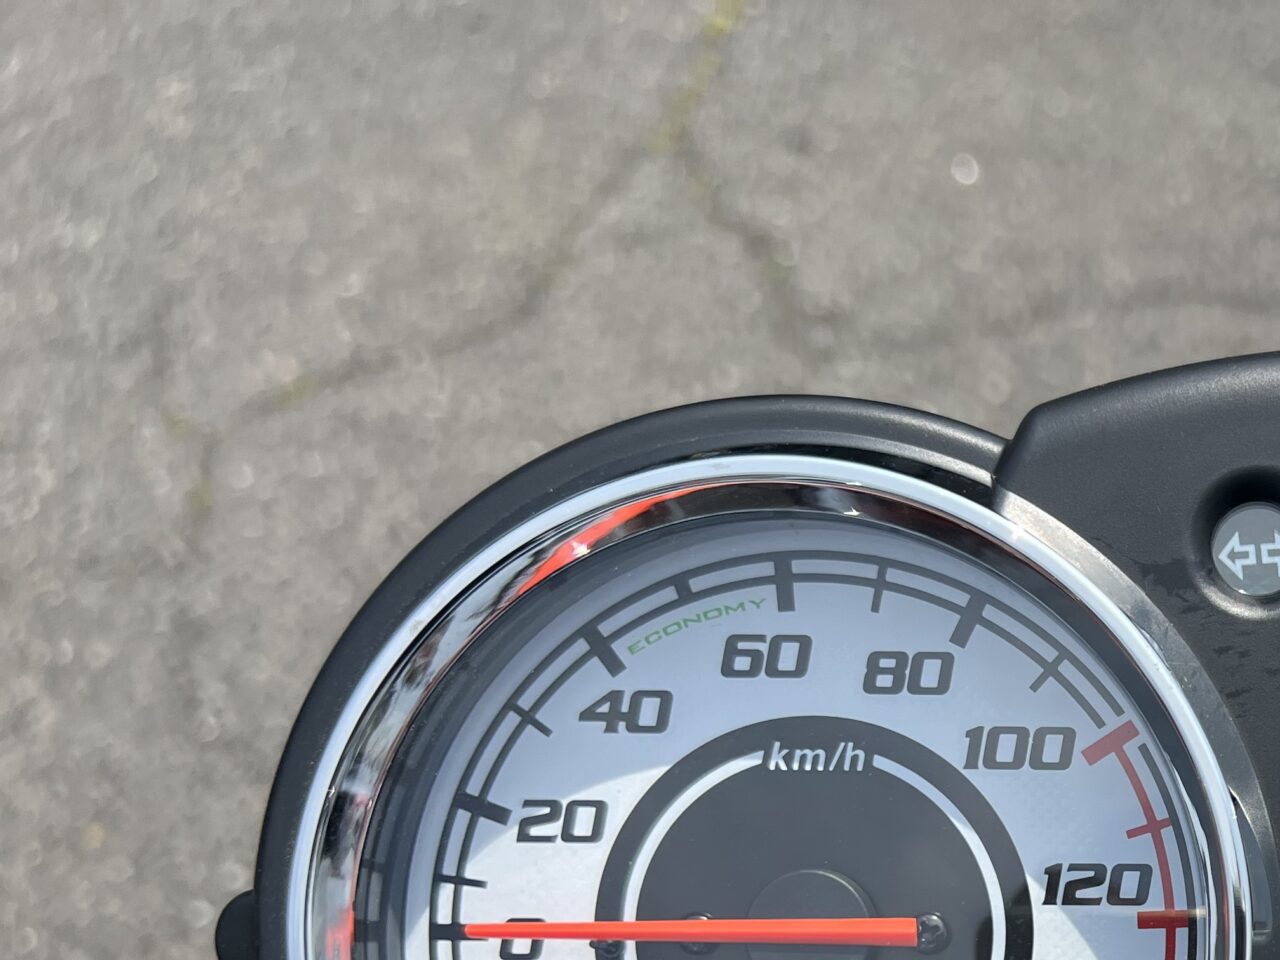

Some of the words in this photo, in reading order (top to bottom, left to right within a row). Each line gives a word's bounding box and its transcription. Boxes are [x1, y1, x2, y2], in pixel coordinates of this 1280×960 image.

[628, 598, 767, 656] ECONOMY
[720, 634, 812, 679] 60
[862, 651, 955, 696] 80
[578, 690, 673, 734] 40
[767, 742, 866, 772] km/h
[963, 726, 1077, 771] 100
[516, 800, 608, 843] 20
[1042, 863, 1154, 906] 120
